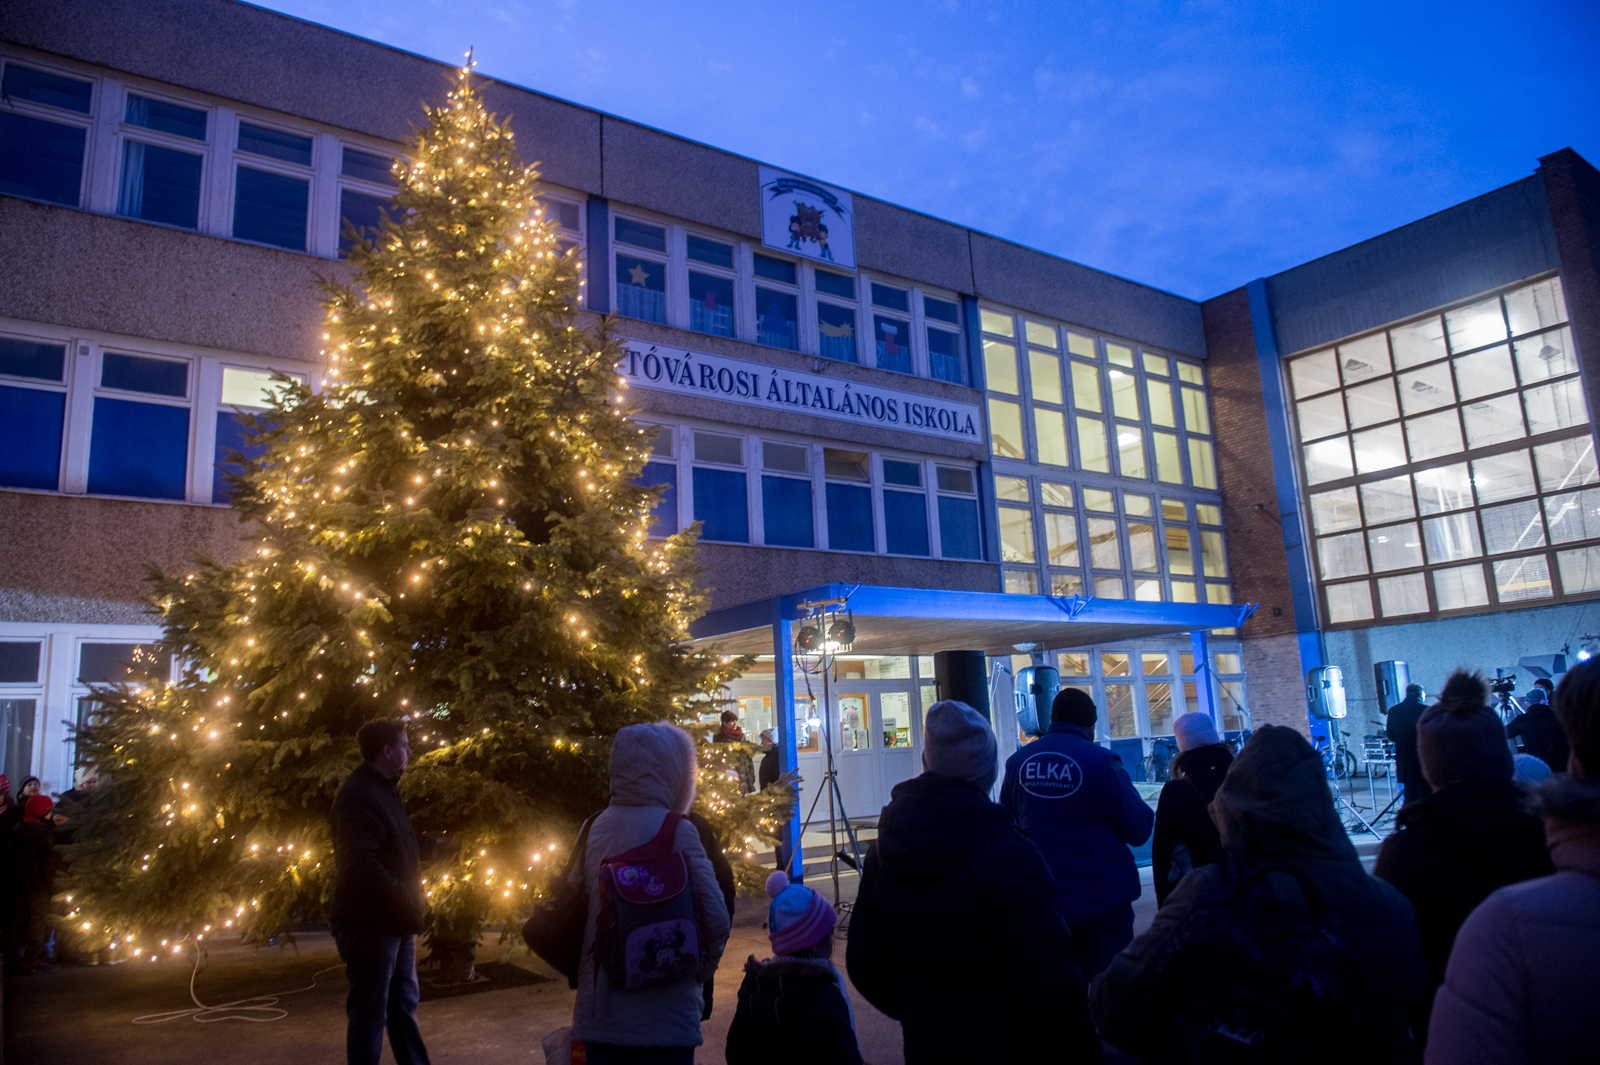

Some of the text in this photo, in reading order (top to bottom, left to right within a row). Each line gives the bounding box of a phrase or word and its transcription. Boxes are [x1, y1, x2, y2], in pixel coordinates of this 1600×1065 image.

[624, 345, 978, 436] TÓVÁROSI ÁLTALÁNOS ISKOLA
